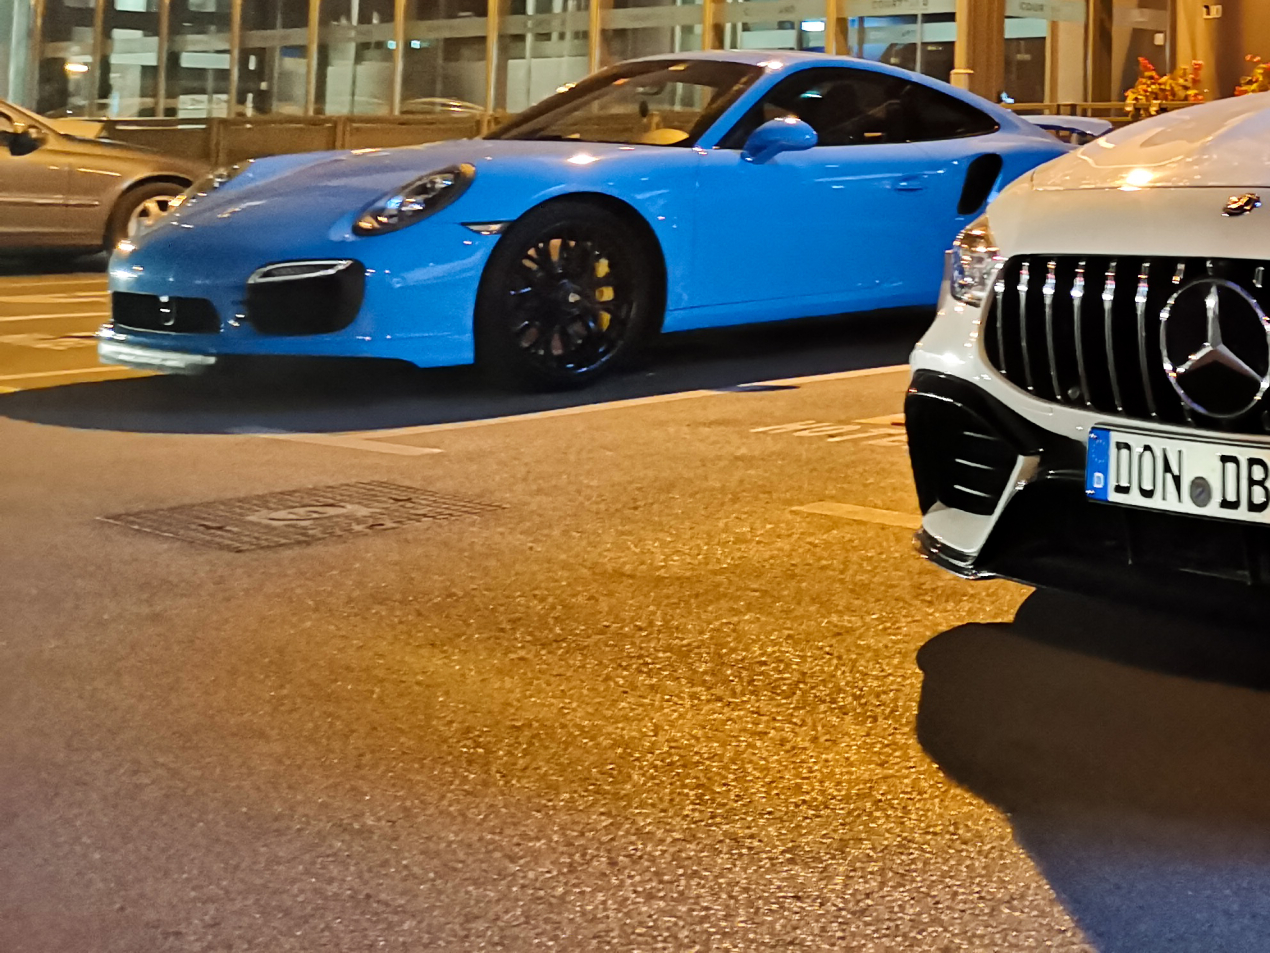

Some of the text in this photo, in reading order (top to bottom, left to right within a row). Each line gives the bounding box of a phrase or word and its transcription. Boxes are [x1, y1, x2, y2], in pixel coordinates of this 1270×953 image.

[1093, 472, 1105, 488] D
[1113, 441, 1183, 503] DON
[1218, 454, 1270, 513] DB
